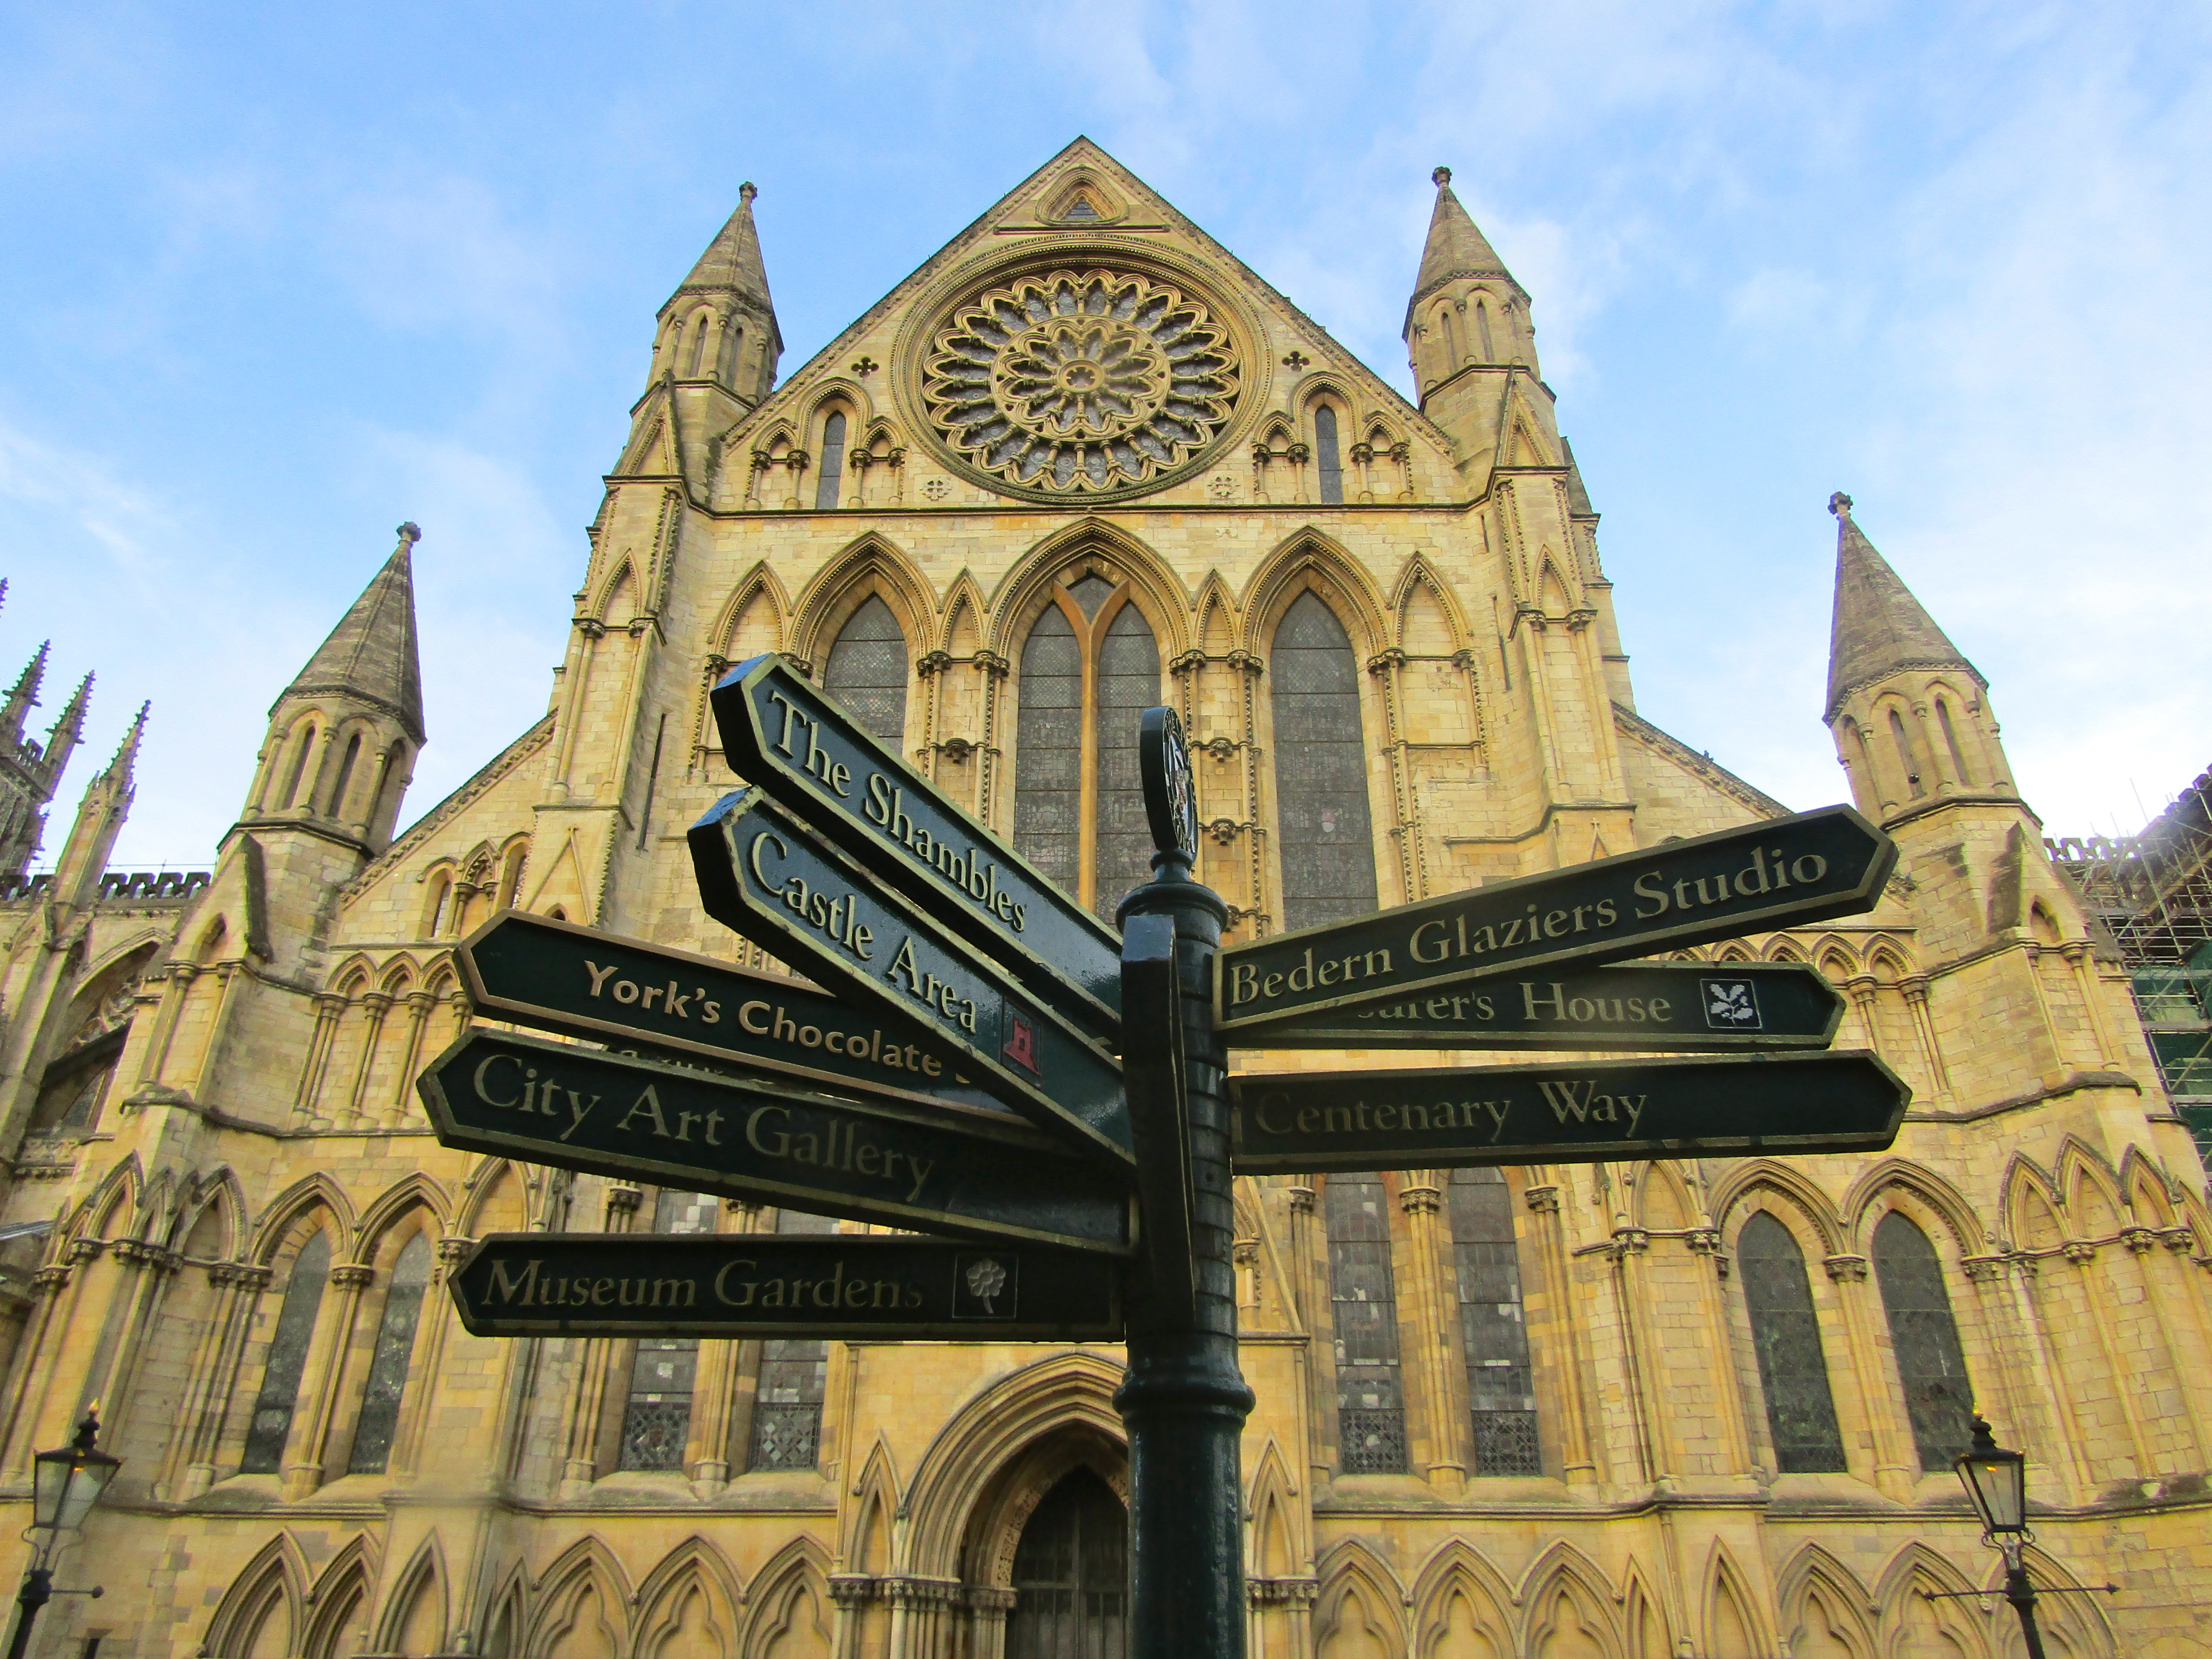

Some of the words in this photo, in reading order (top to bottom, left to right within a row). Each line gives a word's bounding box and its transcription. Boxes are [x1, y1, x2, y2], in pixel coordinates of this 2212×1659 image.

[770, 690, 851, 798] The
[864, 773, 1025, 932] Shambles
[752, 832, 873, 960] Castle
[887, 936, 976, 1033] Area
[1230, 947, 1393, 1005] Bedern
[1409, 897, 1618, 964] Glaziers
[1634, 846, 1828, 918] Studio
[584, 960, 720, 1024] York's
[738, 1000, 942, 1076] Chocolate
[1519, 982, 1673, 1022] House
[474, 1054, 601, 1140] City
[617, 1085, 724, 1146] Art
[747, 1106, 934, 1202] Gallery
[1255, 1093, 1510, 1142] Centenary
[1536, 1080, 1647, 1138] Way
[481, 1260, 697, 1307] Museum
[715, 1258, 924, 1310] Gardens
